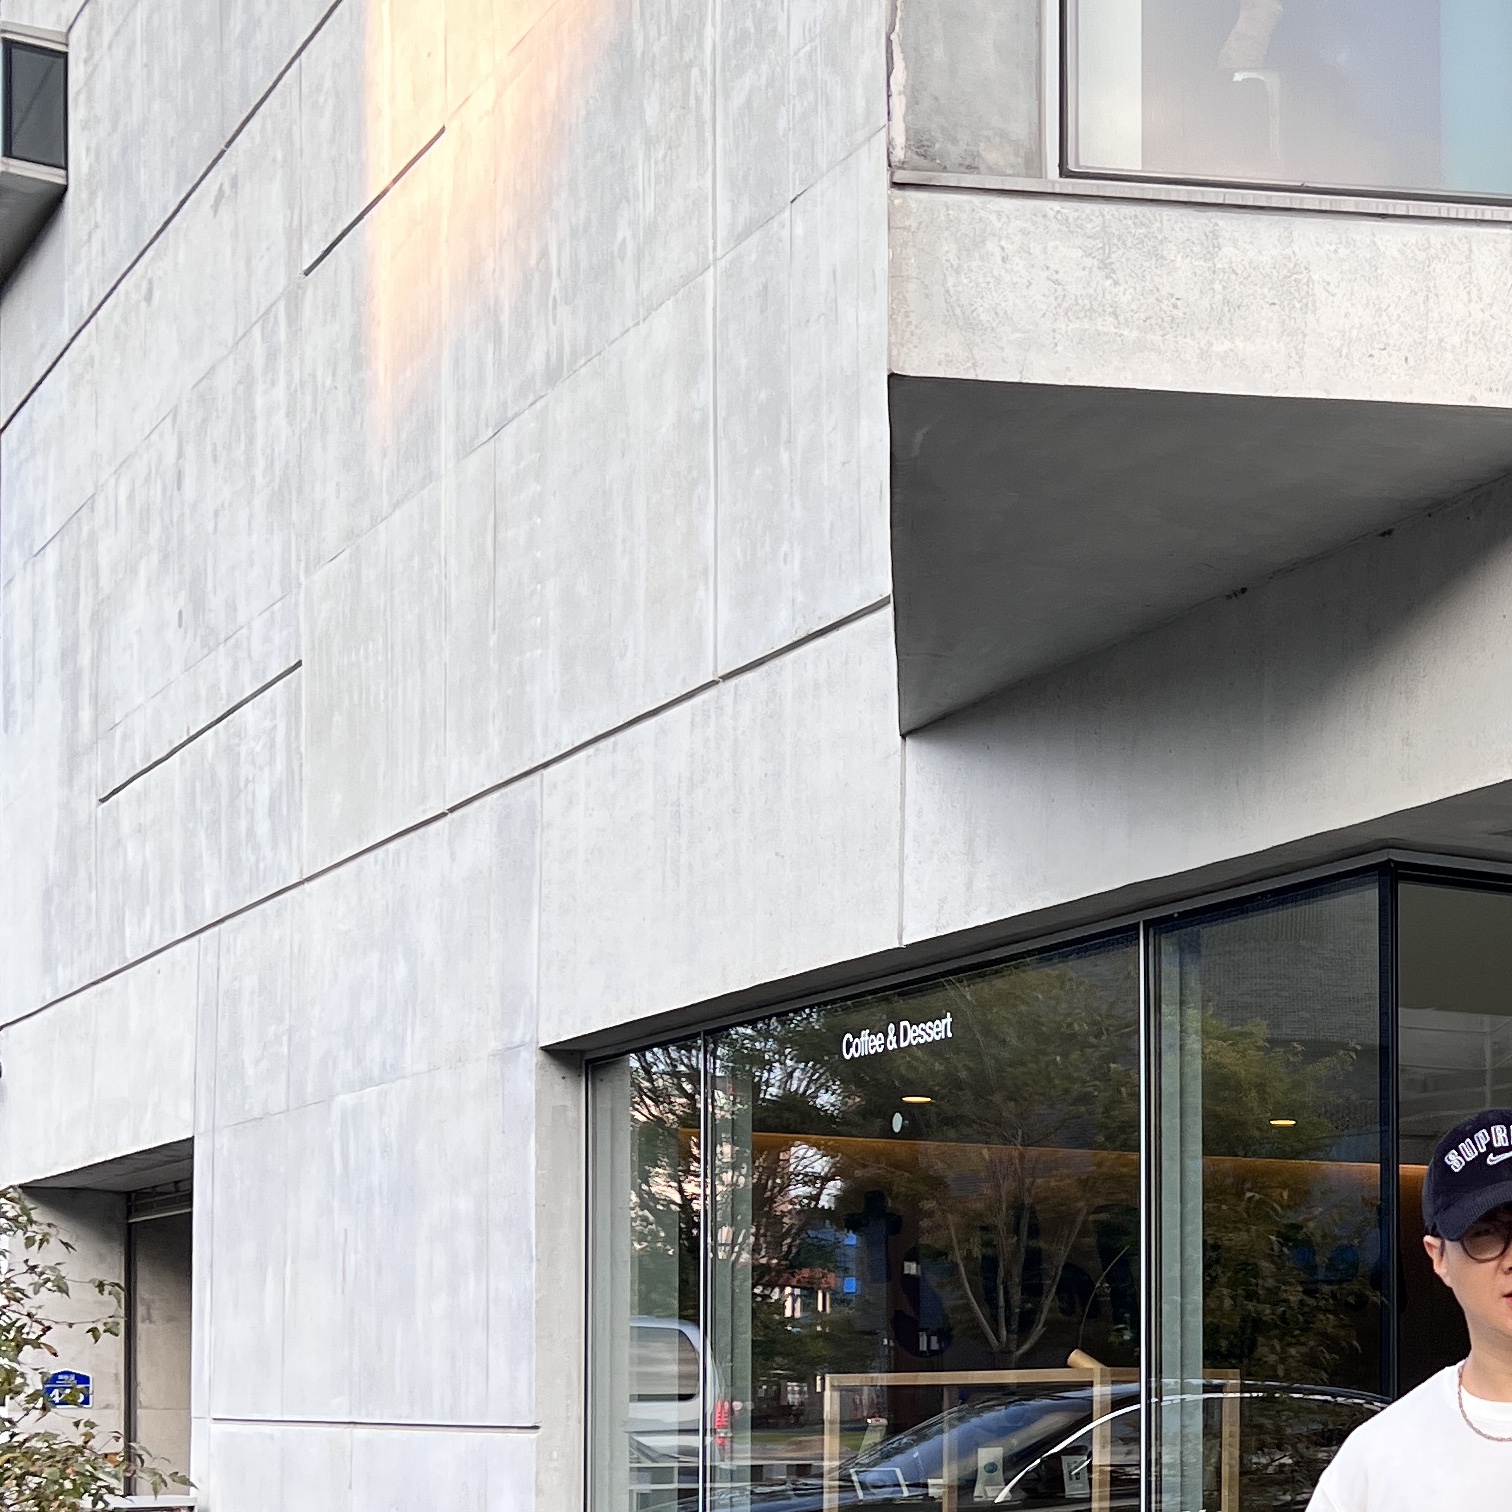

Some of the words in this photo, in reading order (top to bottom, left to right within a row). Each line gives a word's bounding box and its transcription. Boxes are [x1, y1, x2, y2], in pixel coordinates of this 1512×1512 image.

[842, 1029, 885, 1060] Coffee
[886, 1022, 898, 1051] &
[900, 1011, 953, 1048] Dessert
